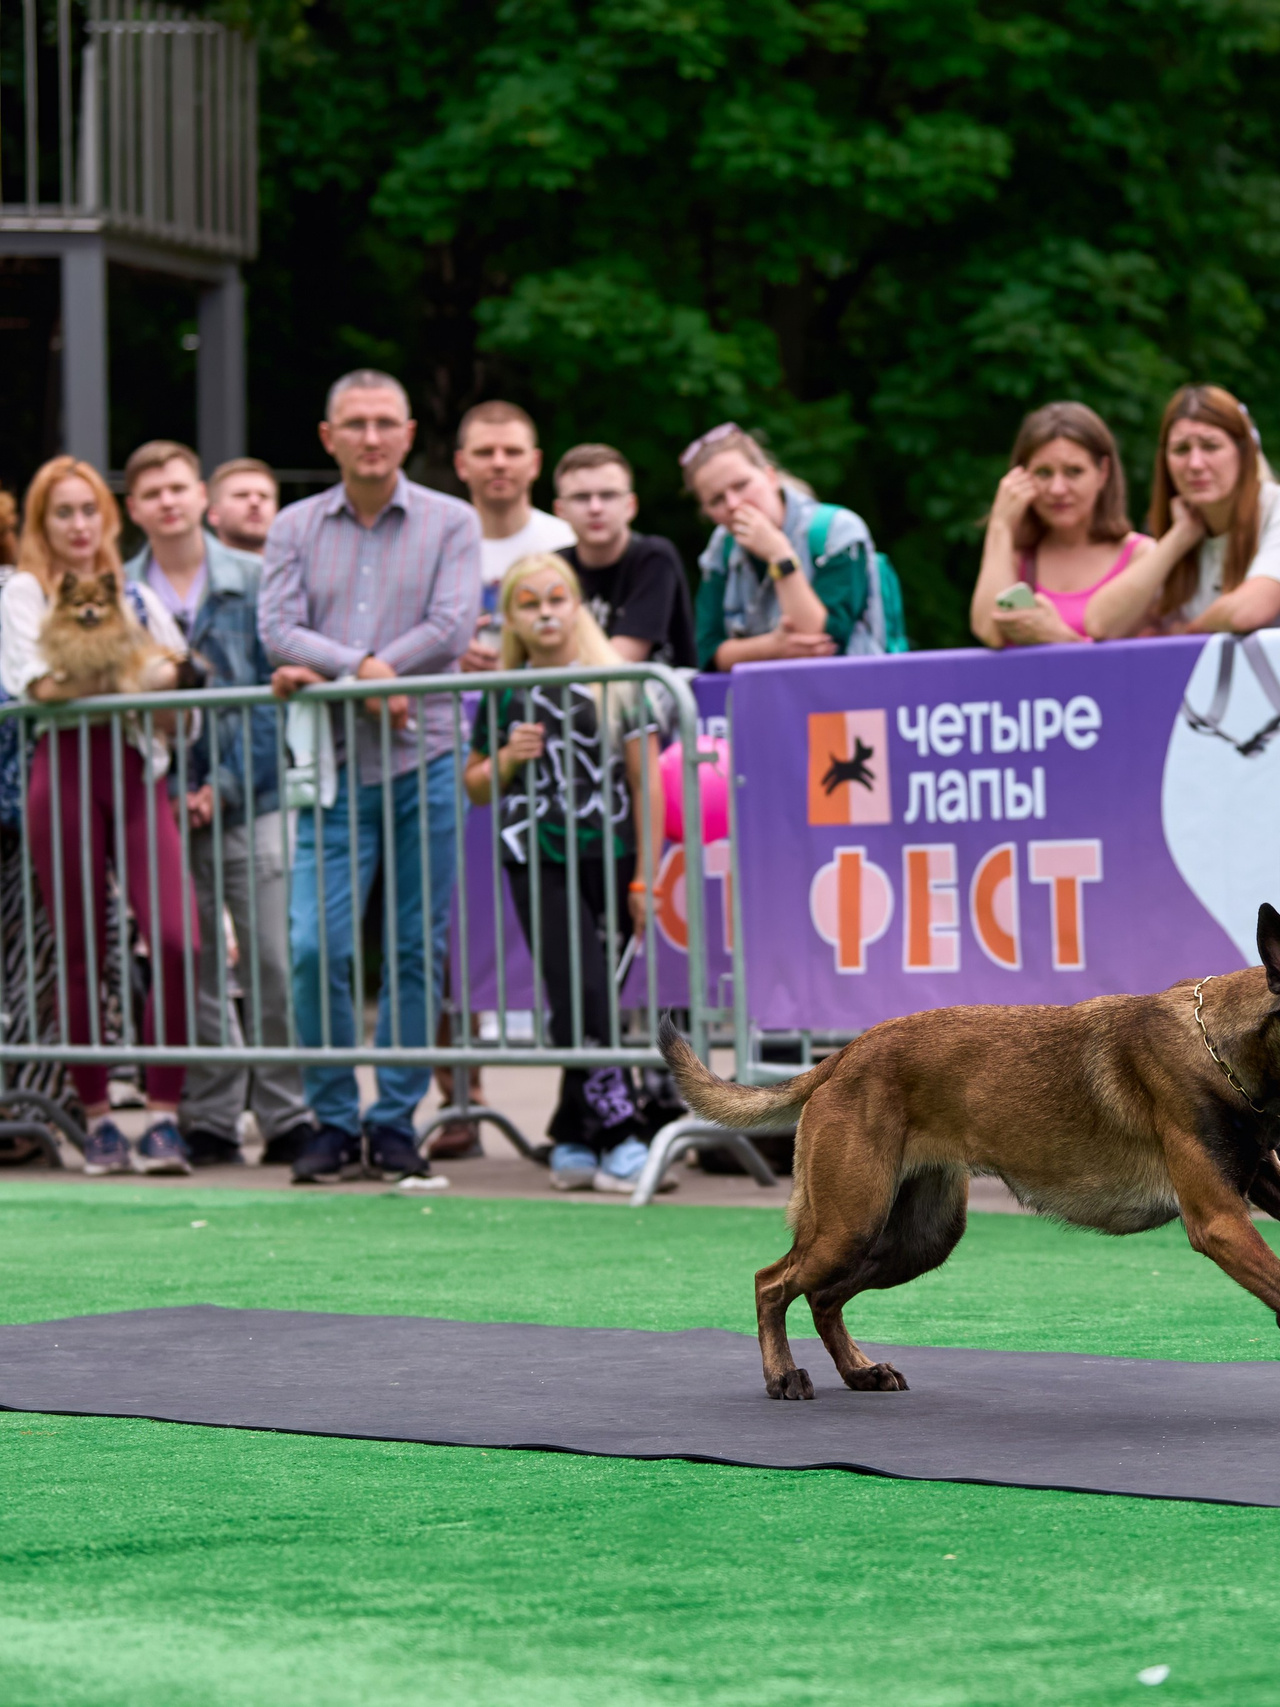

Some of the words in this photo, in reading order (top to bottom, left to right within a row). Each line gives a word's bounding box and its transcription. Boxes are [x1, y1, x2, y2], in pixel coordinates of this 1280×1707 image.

[898, 695, 1102, 756] четыре
[903, 766, 1046, 823] лапы
[809, 838, 1104, 975] ФЕСТ
